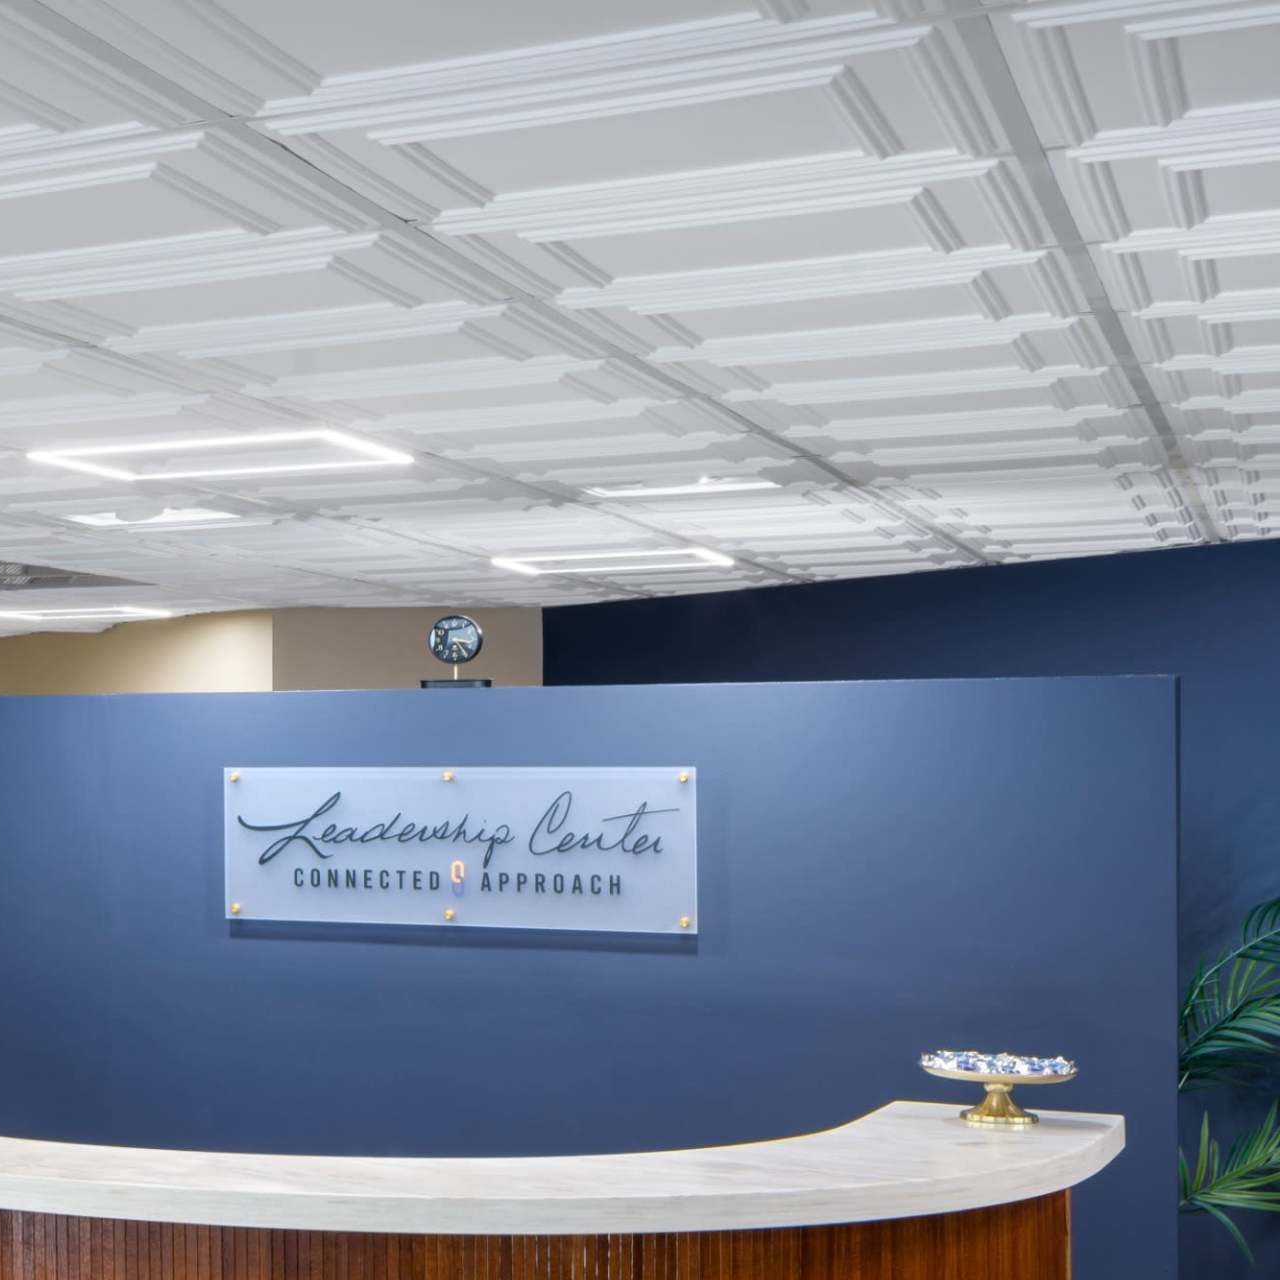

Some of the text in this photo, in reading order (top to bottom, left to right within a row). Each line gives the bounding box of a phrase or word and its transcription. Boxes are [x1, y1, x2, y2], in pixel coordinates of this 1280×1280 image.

[237, 791, 680, 868] Leadership Center
[293, 867, 623, 896] CONNECTED APPROACH
